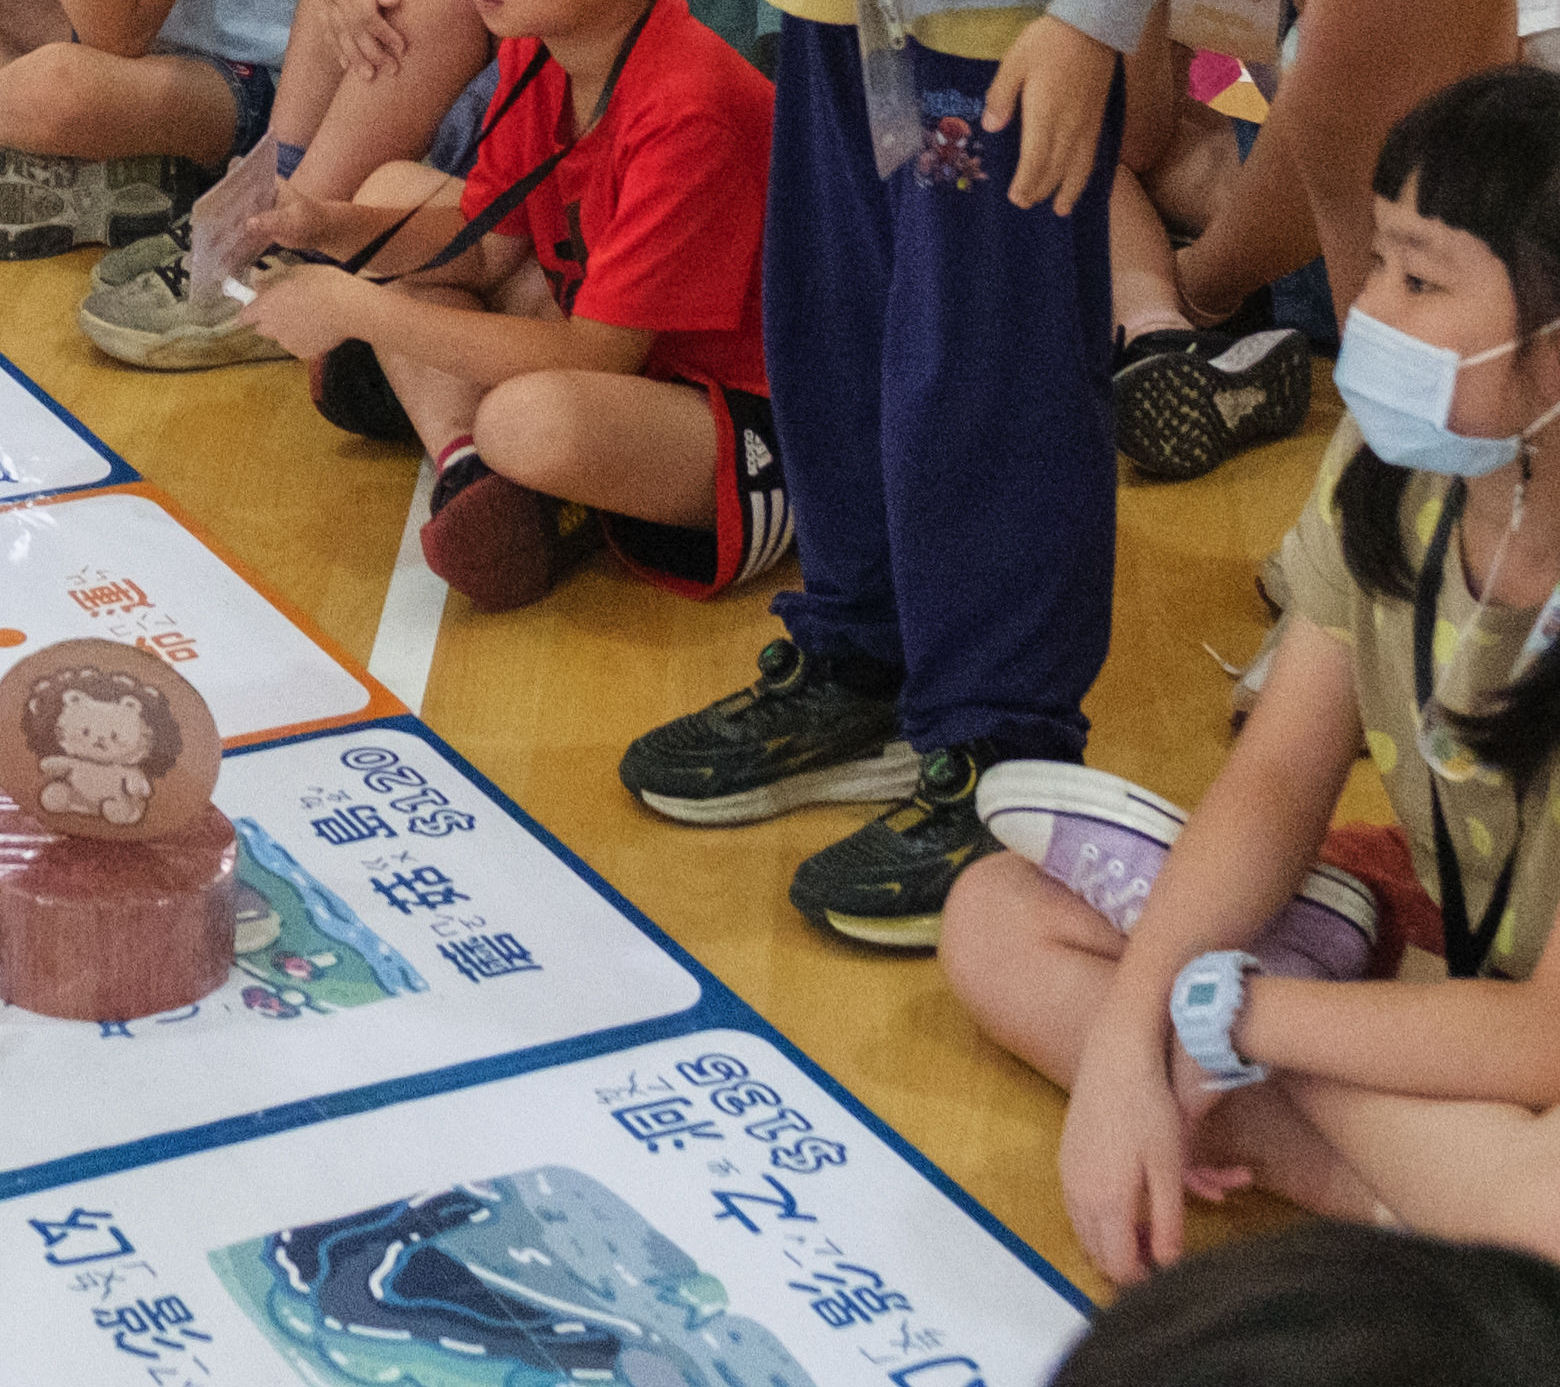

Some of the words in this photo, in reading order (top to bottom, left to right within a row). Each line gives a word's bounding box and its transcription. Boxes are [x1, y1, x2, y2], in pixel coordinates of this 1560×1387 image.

[339, 745, 477, 838] $120
[310, 802, 545, 986] 蘑菇島
[675, 1052, 848, 1175] $135
[27, 1206, 214, 1361] 幻影
